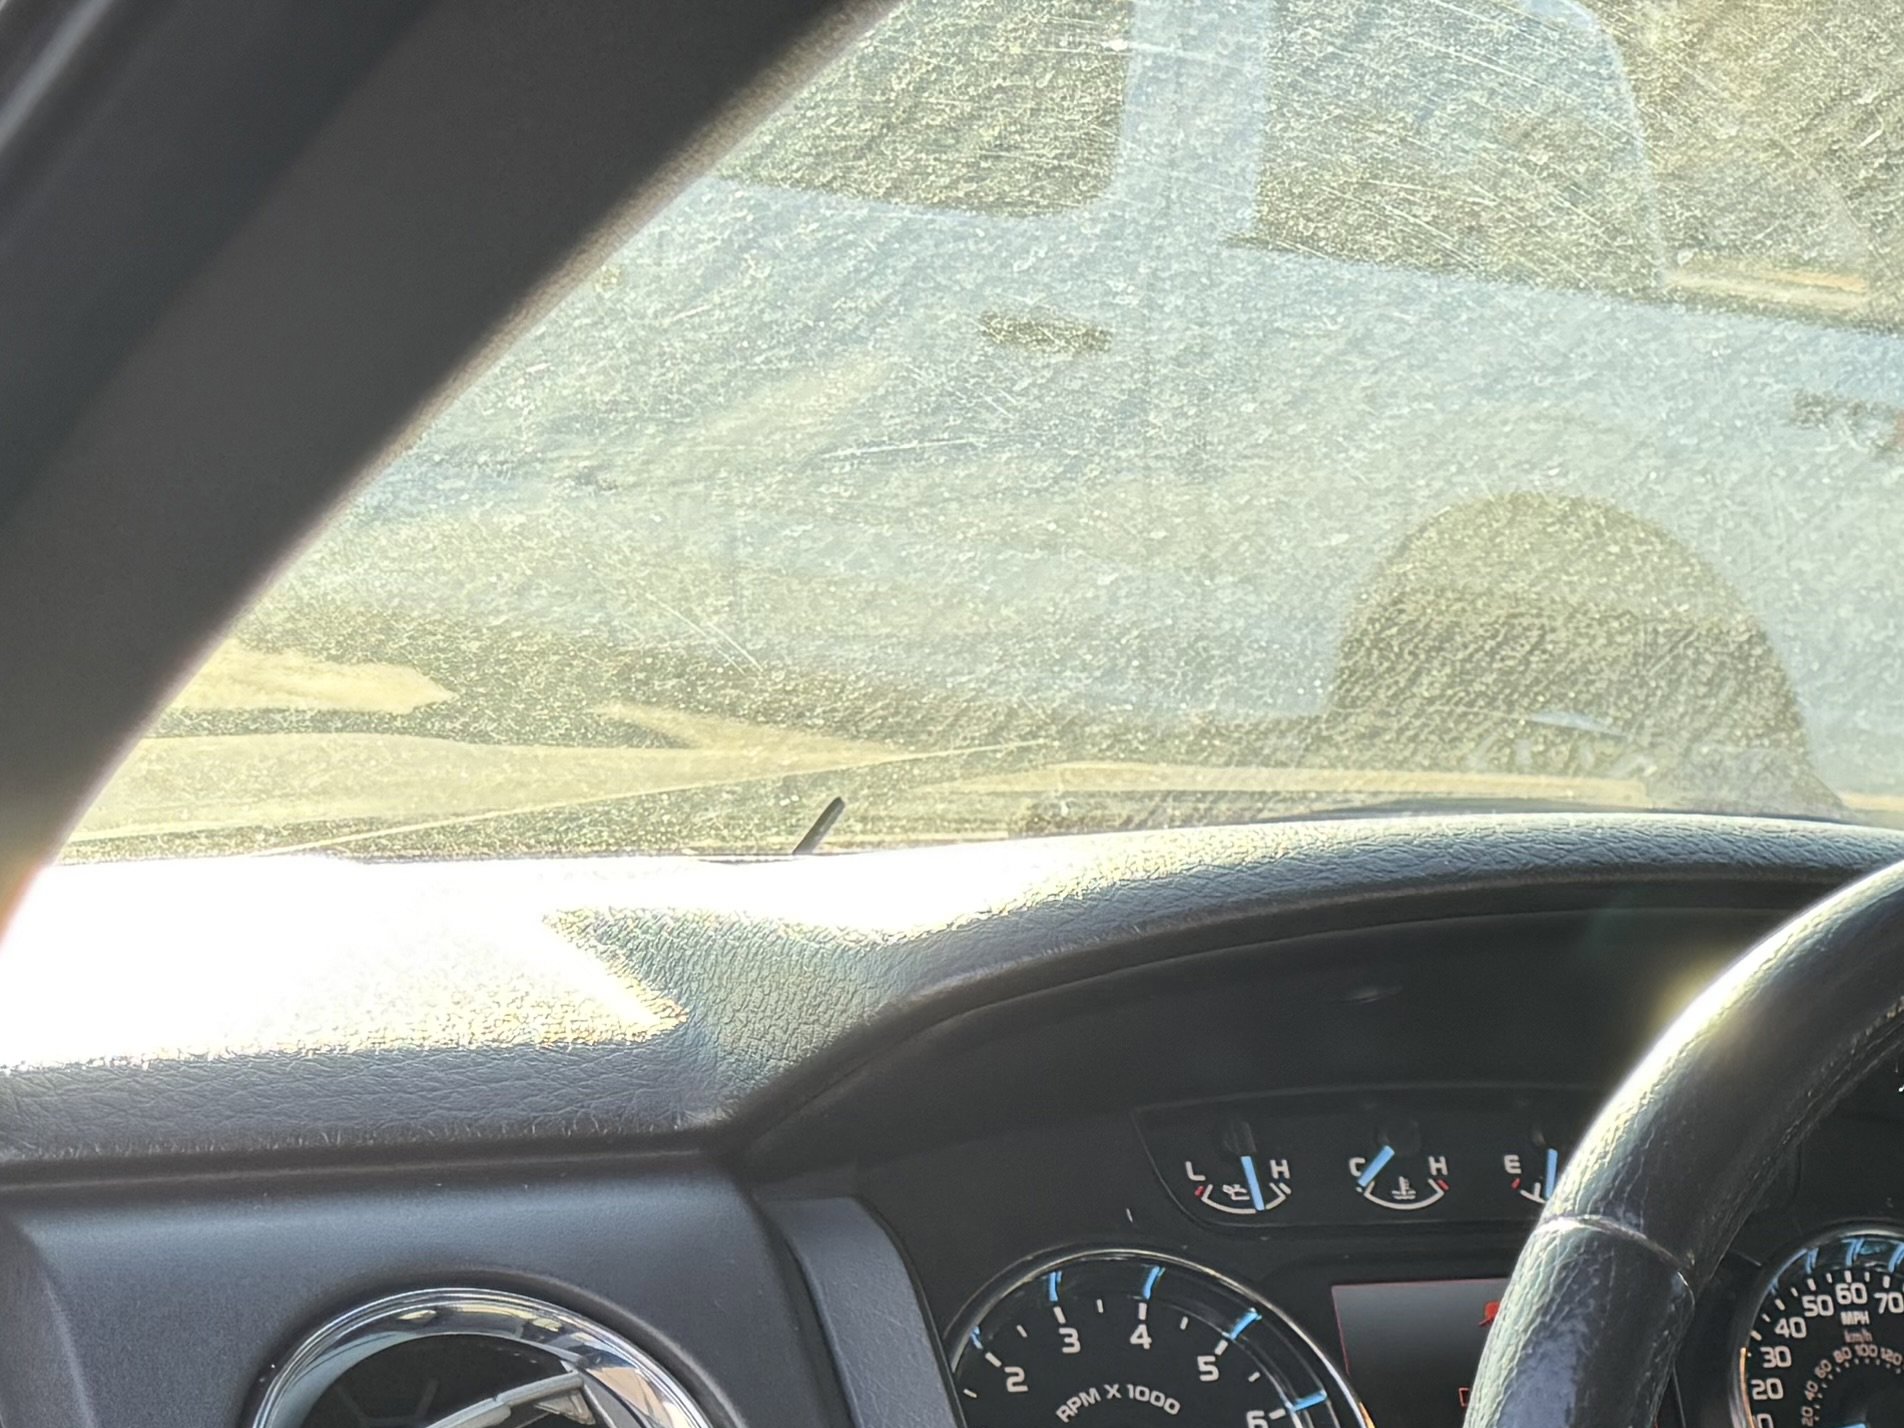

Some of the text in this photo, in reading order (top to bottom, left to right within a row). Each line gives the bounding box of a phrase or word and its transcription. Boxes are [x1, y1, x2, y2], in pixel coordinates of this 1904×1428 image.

[1185, 1161, 1206, 1181] L
[1270, 1159, 1290, 1179] H
[1428, 1156, 1449, 1176] H
[1504, 1155, 1521, 1174] E
[1835, 1282, 1868, 1305] 60
[1873, 1291, 1904, 1314] 70
[1802, 1294, 1834, 1317] 50
[1774, 1316, 1807, 1339] 40
[1840, 1310, 1870, 1325] MPH
[1059, 1327, 1081, 1354] 3
[1130, 1324, 1152, 1349] 4
[1760, 1345, 1792, 1368] 30
[1854, 1344, 1878, 1358] 100
[1004, 1366, 1028, 1392] 2
[1197, 1355, 1219, 1382] 5
[1751, 1377, 1784, 1400] 20
[1056, 1384, 1180, 1423] RPM X 1000
